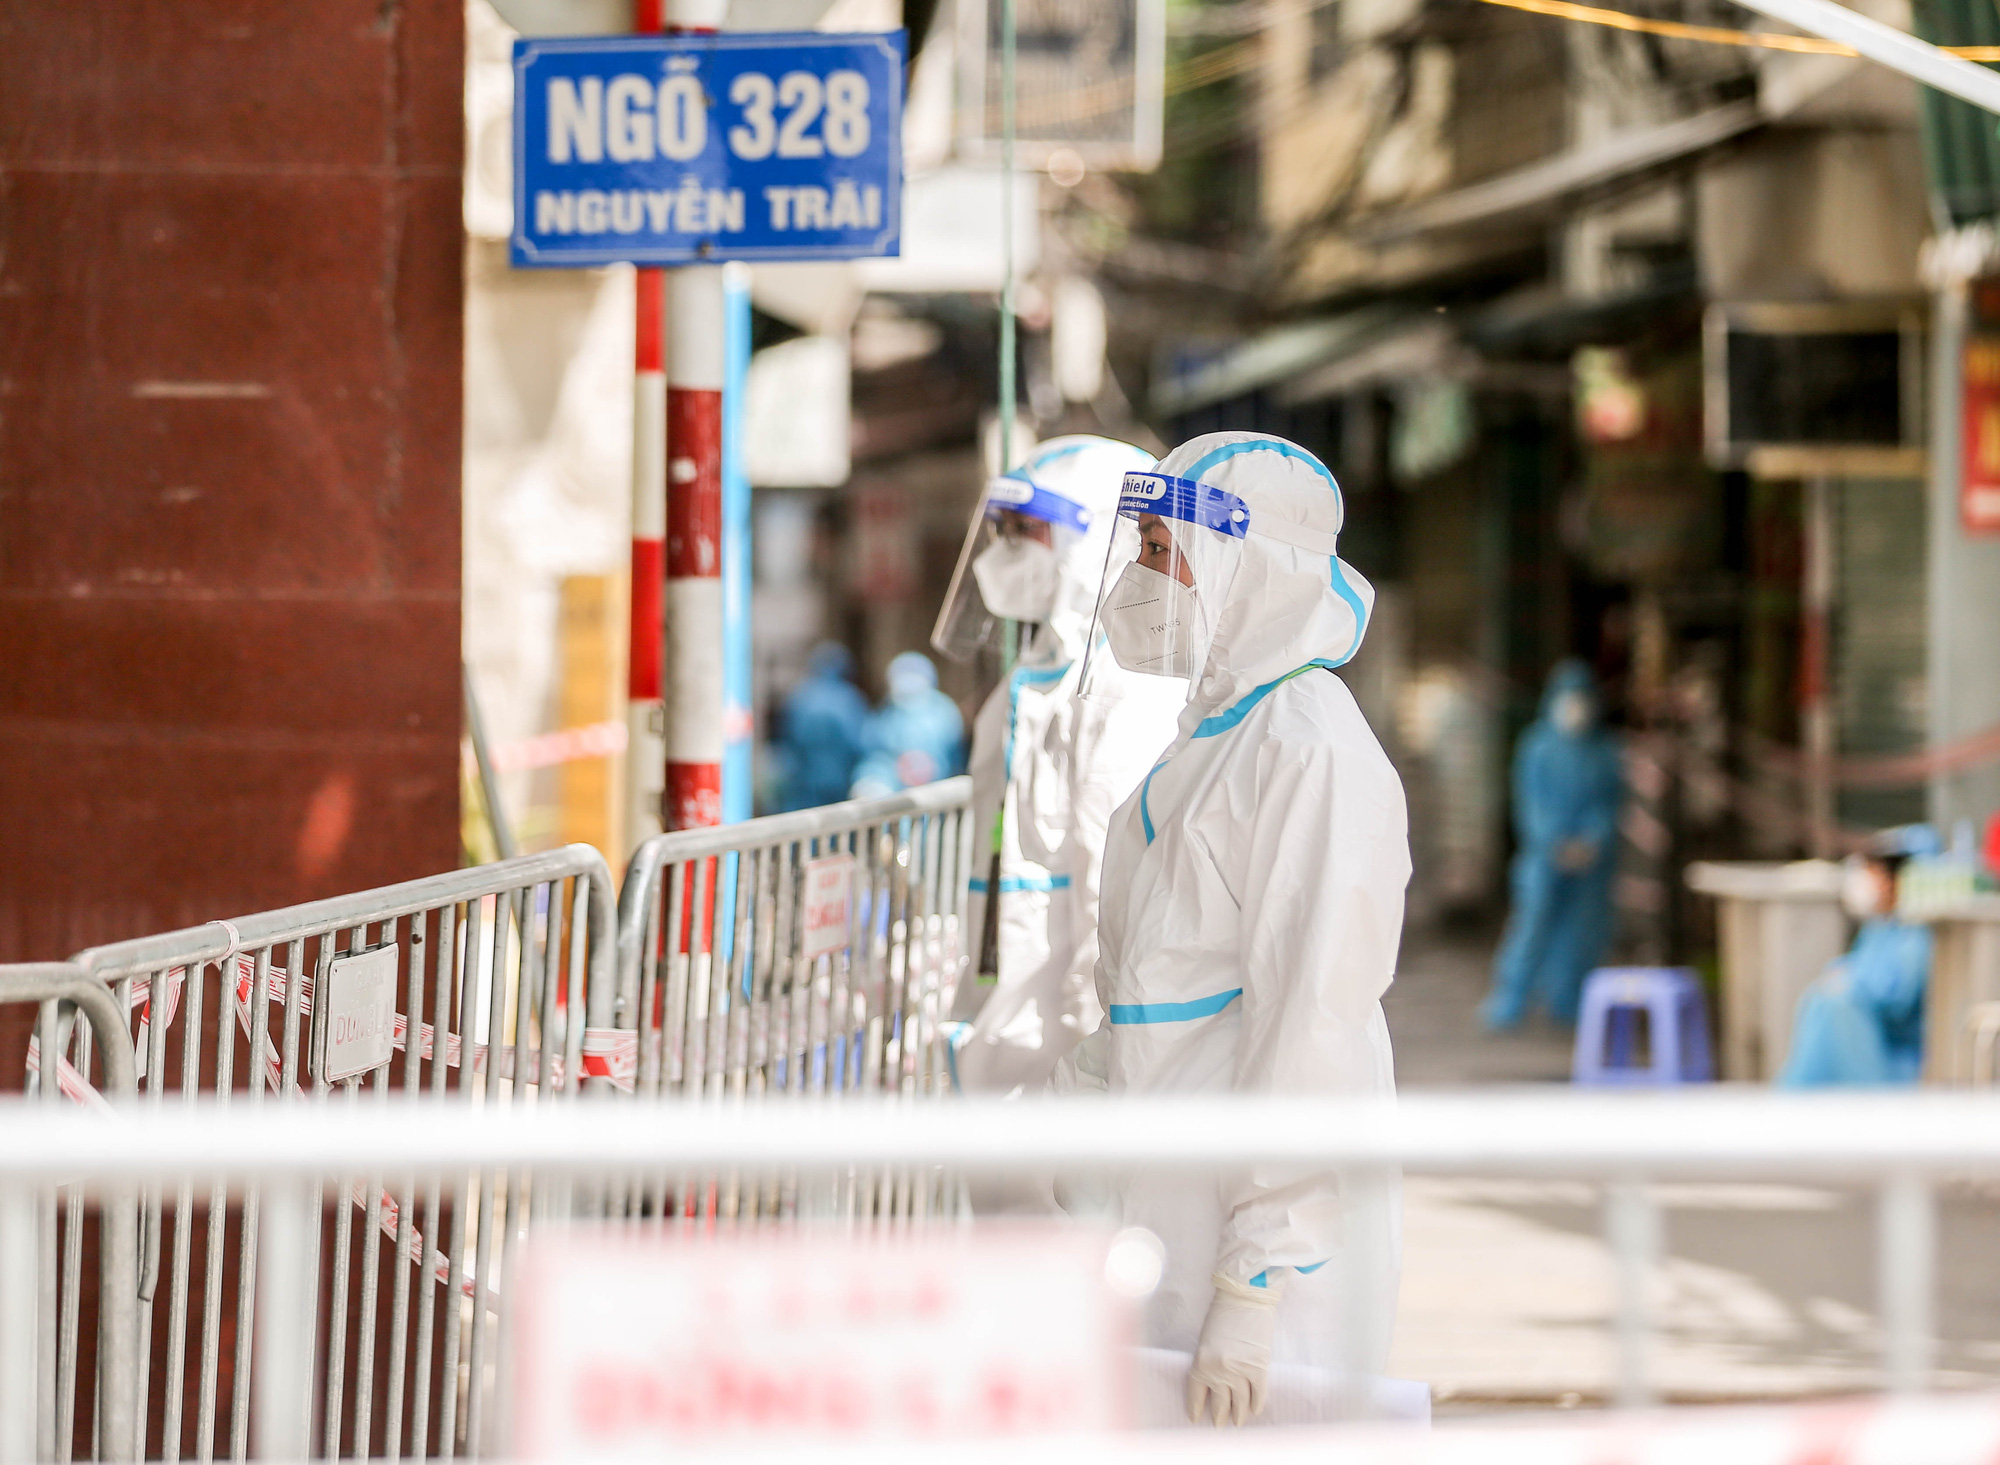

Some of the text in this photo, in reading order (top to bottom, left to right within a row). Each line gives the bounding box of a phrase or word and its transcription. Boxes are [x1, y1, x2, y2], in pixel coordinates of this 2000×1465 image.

[547, 57, 870, 163] NGÕ 328
[536, 174, 881, 233] NGUYỄN TRÃI
